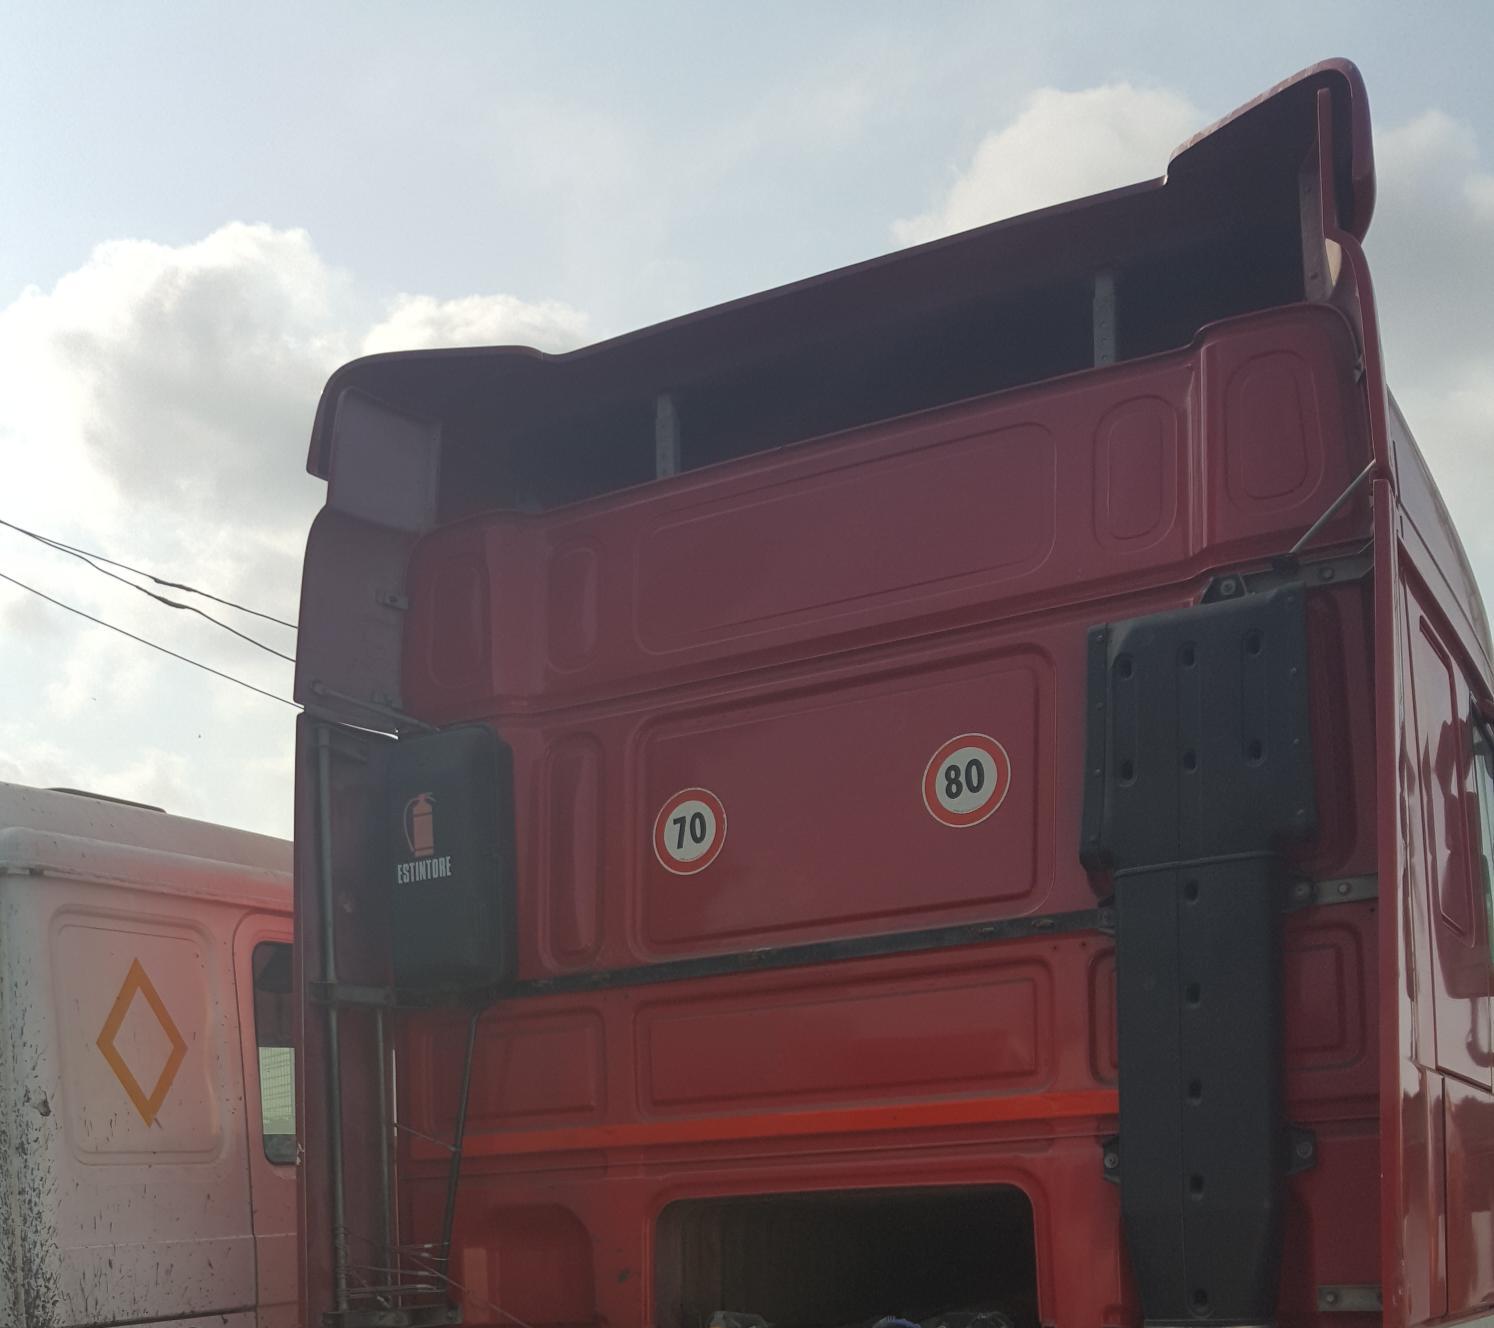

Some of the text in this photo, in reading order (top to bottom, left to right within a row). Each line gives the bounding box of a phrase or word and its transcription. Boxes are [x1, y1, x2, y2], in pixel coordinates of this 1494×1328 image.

[943, 757, 985, 799] 80
[672, 811, 707, 849] 70
[397, 856, 452, 884] ESTINTORE
